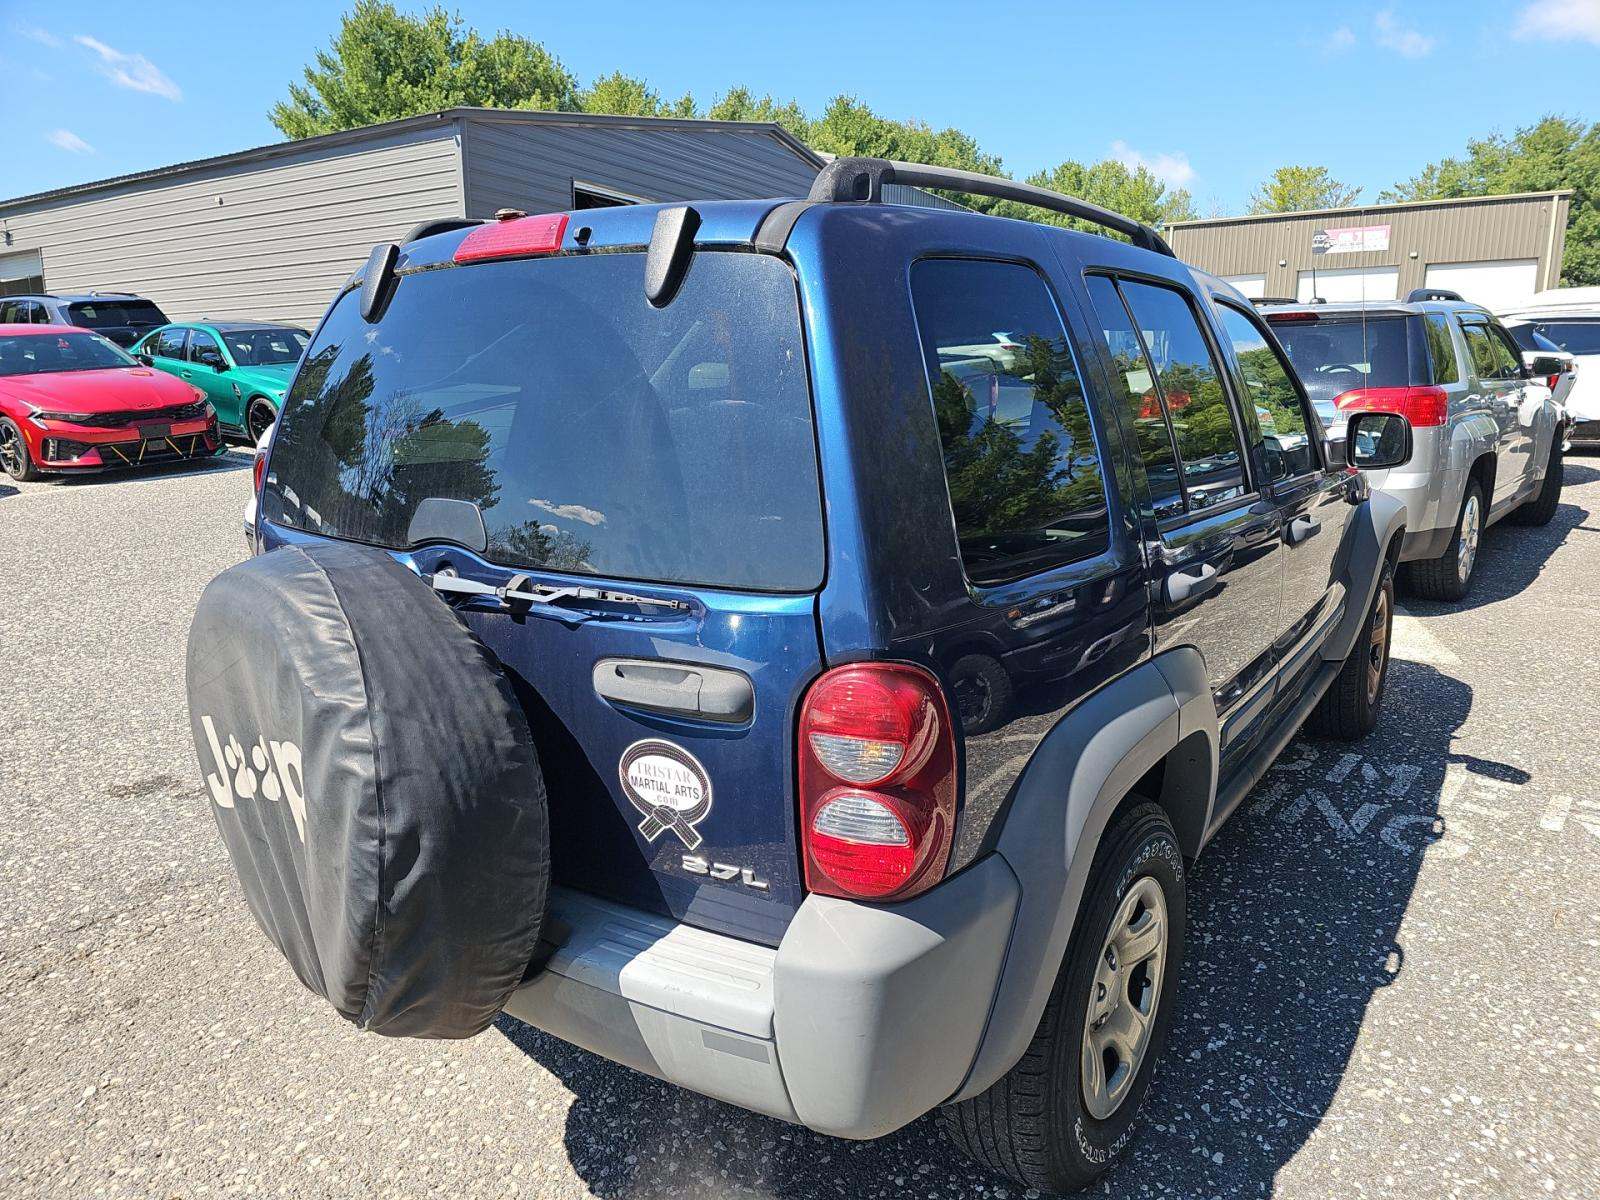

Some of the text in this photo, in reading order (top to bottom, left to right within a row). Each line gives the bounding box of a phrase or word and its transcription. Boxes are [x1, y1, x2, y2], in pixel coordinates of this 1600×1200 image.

[201, 715, 307, 845] Jeep
[635, 761, 691, 784] TRISTAR
[630, 775, 700, 800] MARTIAL ARTS
